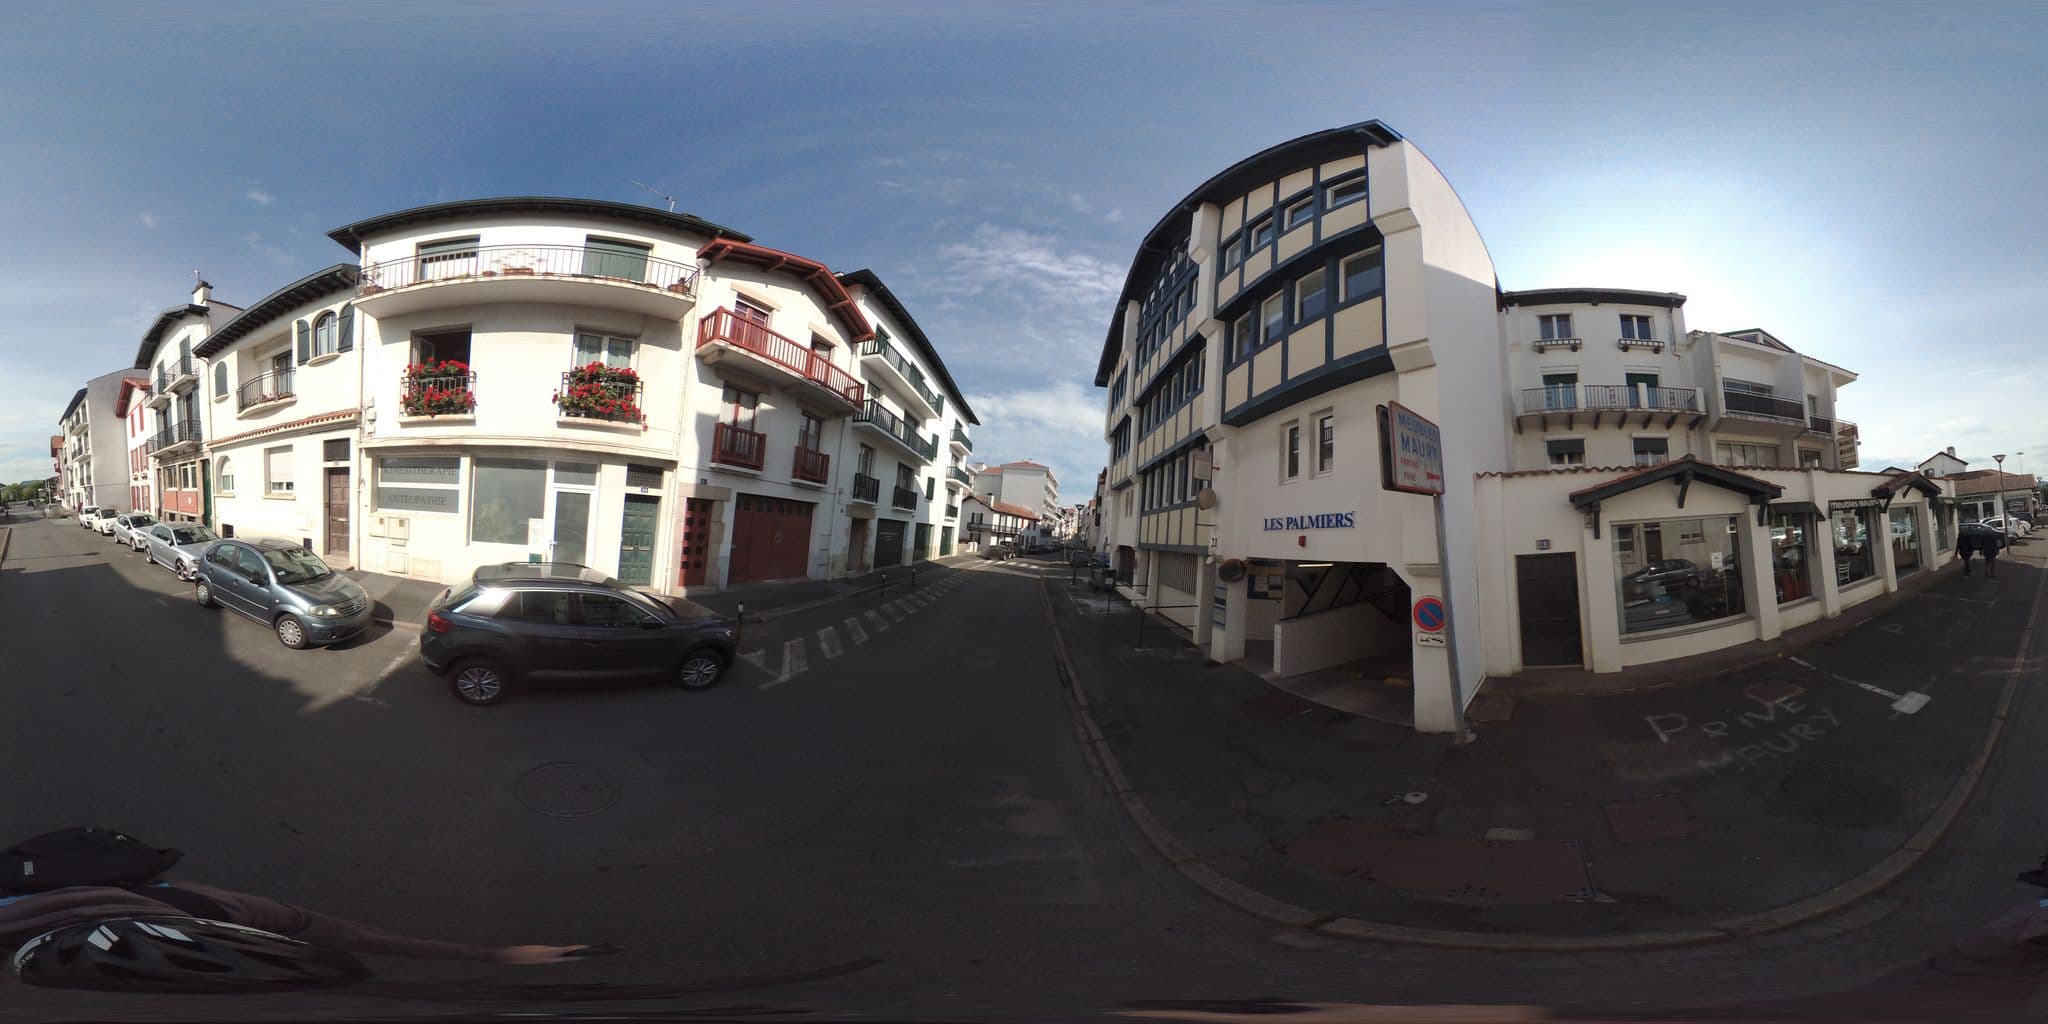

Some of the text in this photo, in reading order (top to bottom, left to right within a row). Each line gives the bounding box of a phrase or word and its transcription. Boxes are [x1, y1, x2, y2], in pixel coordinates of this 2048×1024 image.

[1401, 433, 1437, 462] MAURY
[388, 494, 448, 506] OSTEOPATHIE
[1264, 513, 1353, 531] LES PALMIERS
